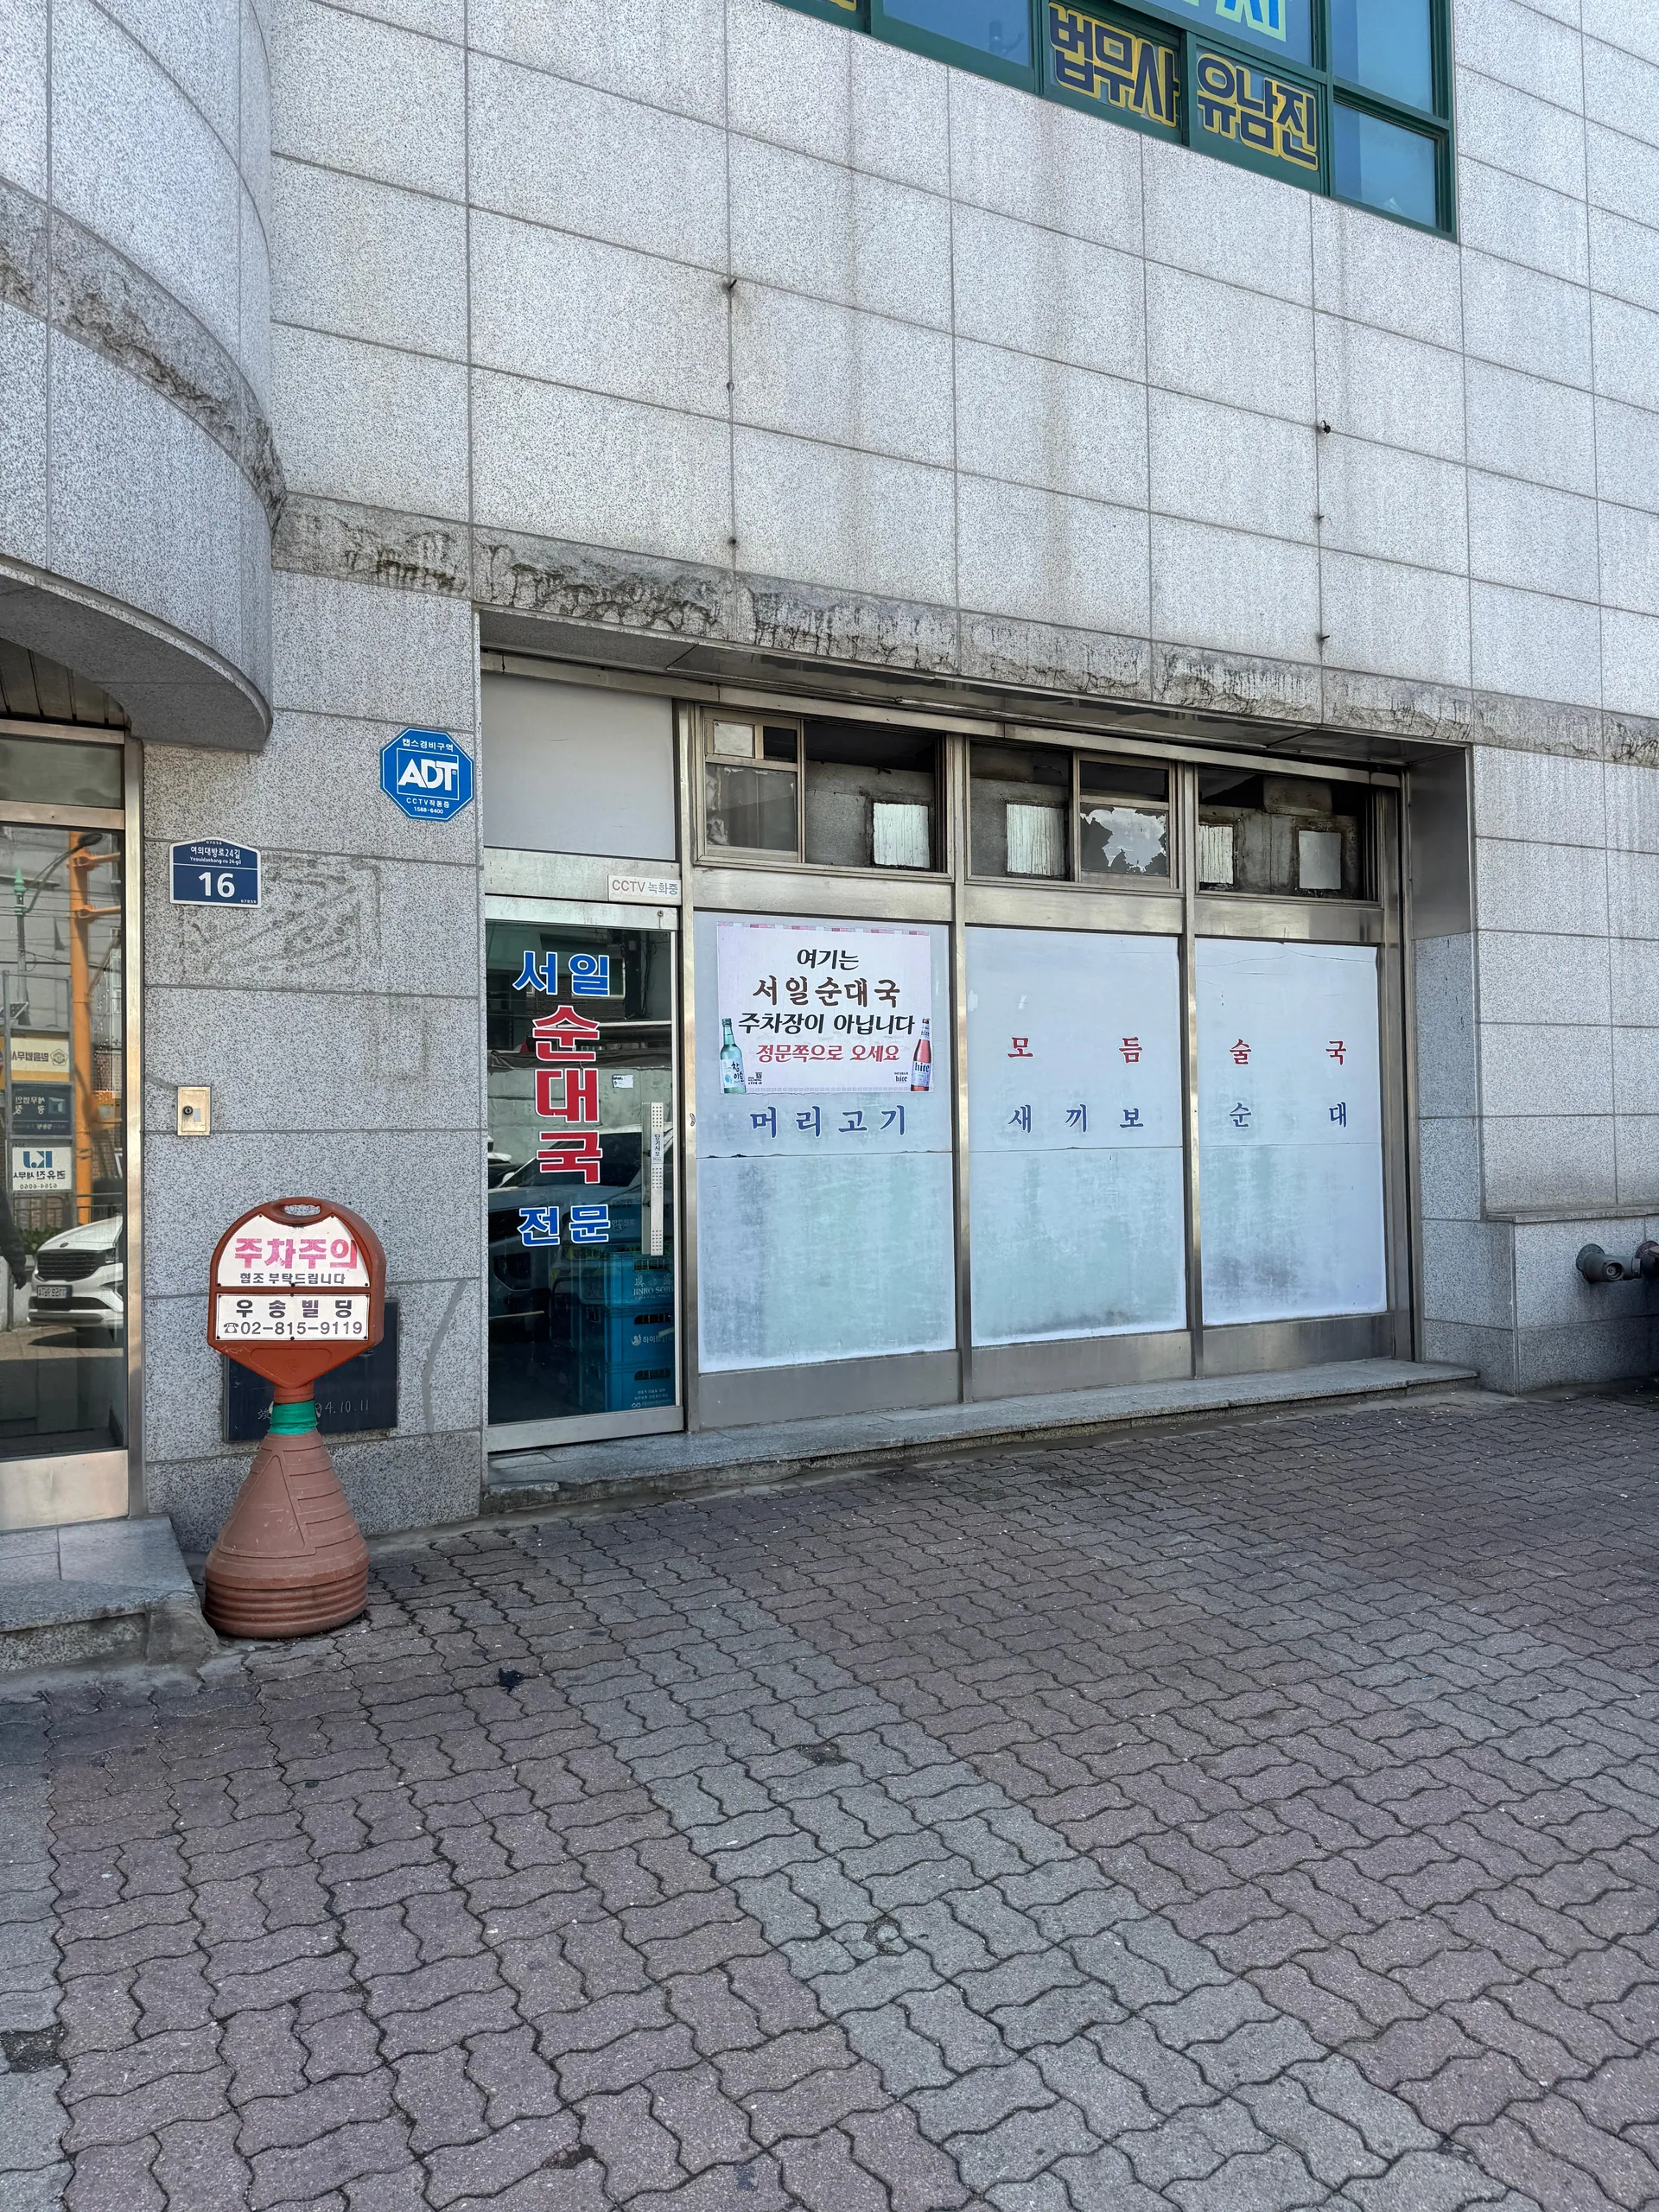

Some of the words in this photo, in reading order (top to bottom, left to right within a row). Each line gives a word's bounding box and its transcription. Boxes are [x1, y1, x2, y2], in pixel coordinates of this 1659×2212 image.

[1049, 3, 1180, 127] 법무사
[1197, 54, 1318, 171] 유남진
[403, 738, 454, 752] 캡스경비구역
[398, 758, 458, 791] ADT
[190, 846, 240, 859] 여의대방로24길
[199, 872, 235, 898] 16
[612, 880, 645, 893] CCTV
[648, 882, 678, 895] 녹화중
[797, 949, 859, 970] 여기는
[512, 951, 610, 996] 서일
[753, 975, 900, 1007] 서일순대국
[738, 1013, 824, 1034] 주차장이
[833, 1014, 915, 1035] 아닙니다
[756, 1045, 844, 1063] 정문쪽으로
[849, 1045, 900, 1062] 오세요
[914, 1062, 930, 1072] hite
[532, 1005, 603, 1184] 순대국
[749, 1104, 906, 1139] 머리고기
[1008, 1103, 1144, 1134] 새끼보
[518, 1204, 611, 1246] 전문
[234, 1238, 359, 1269] 주차주의
[240, 1273, 264, 1284] 협조
[269, 1273, 346, 1284] 부탁드립니다
[236, 1300, 353, 1319] 우송빌딩
[240, 1321, 363, 1335] 02-815-9119
